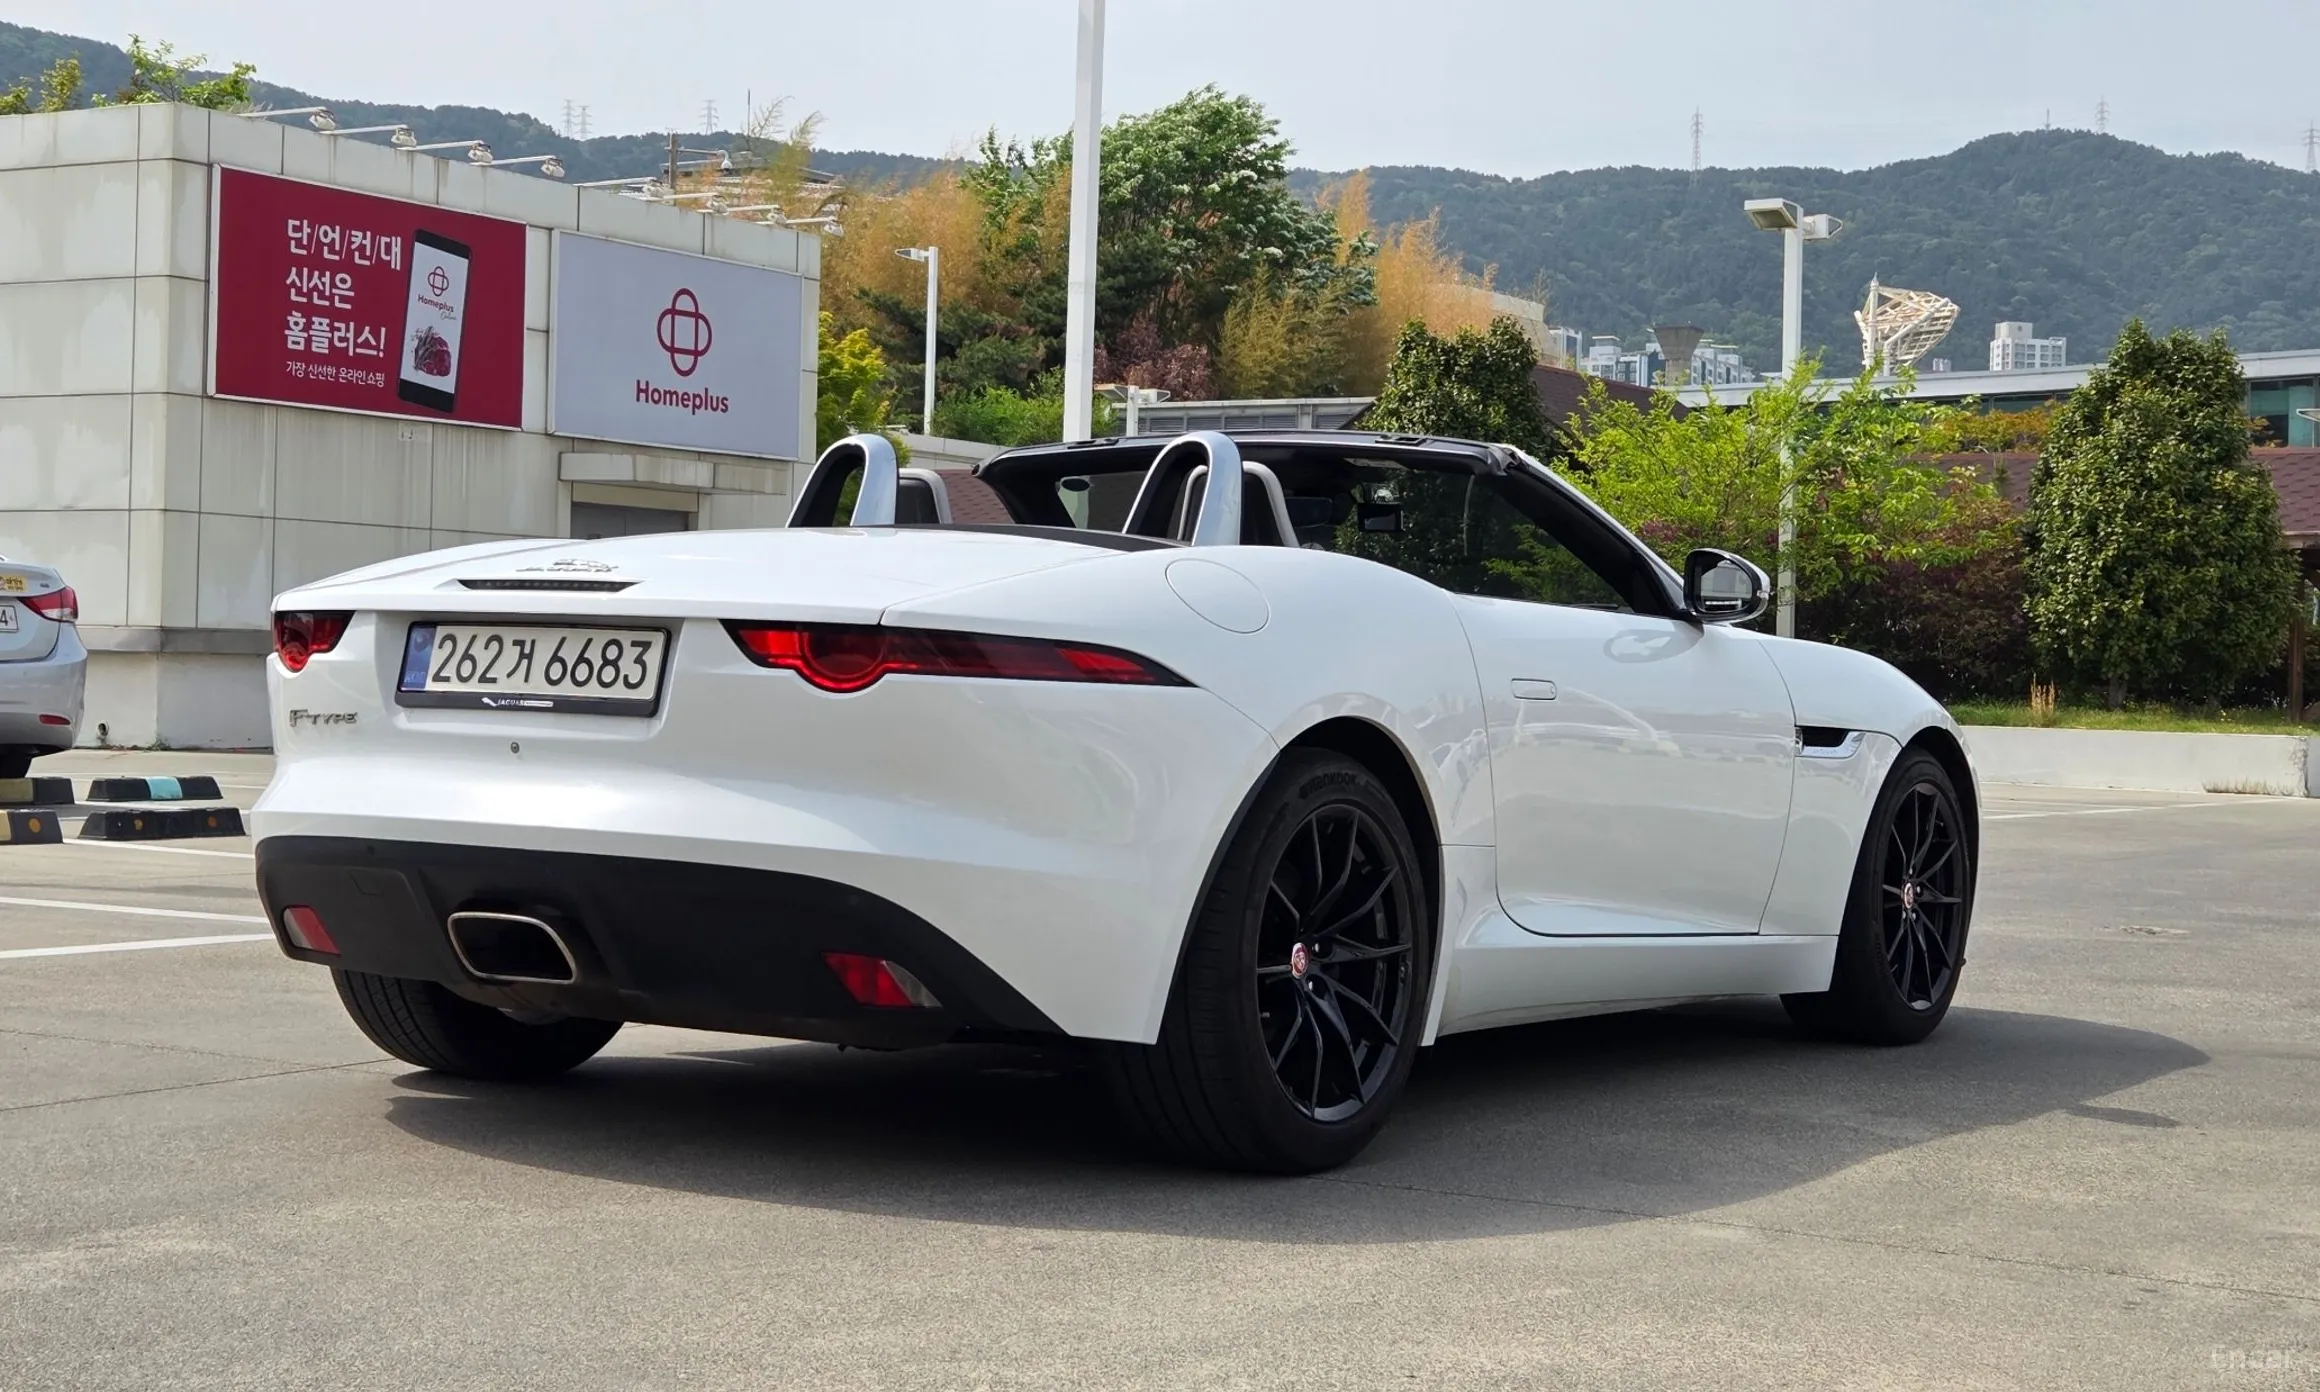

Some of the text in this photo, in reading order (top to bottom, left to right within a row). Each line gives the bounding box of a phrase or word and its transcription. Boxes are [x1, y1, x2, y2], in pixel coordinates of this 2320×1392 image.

[287, 219, 402, 270] 단/언/컨/대
[285, 266, 354, 310] 신선은
[417, 294, 454, 313] Homeplus
[284, 311, 386, 358] 홈플러스!
[286, 361, 306, 377] 가장
[308, 363, 336, 381] 신선한
[635, 379, 729, 415] Homeplus
[432, 633, 653, 690] 262거 6683
